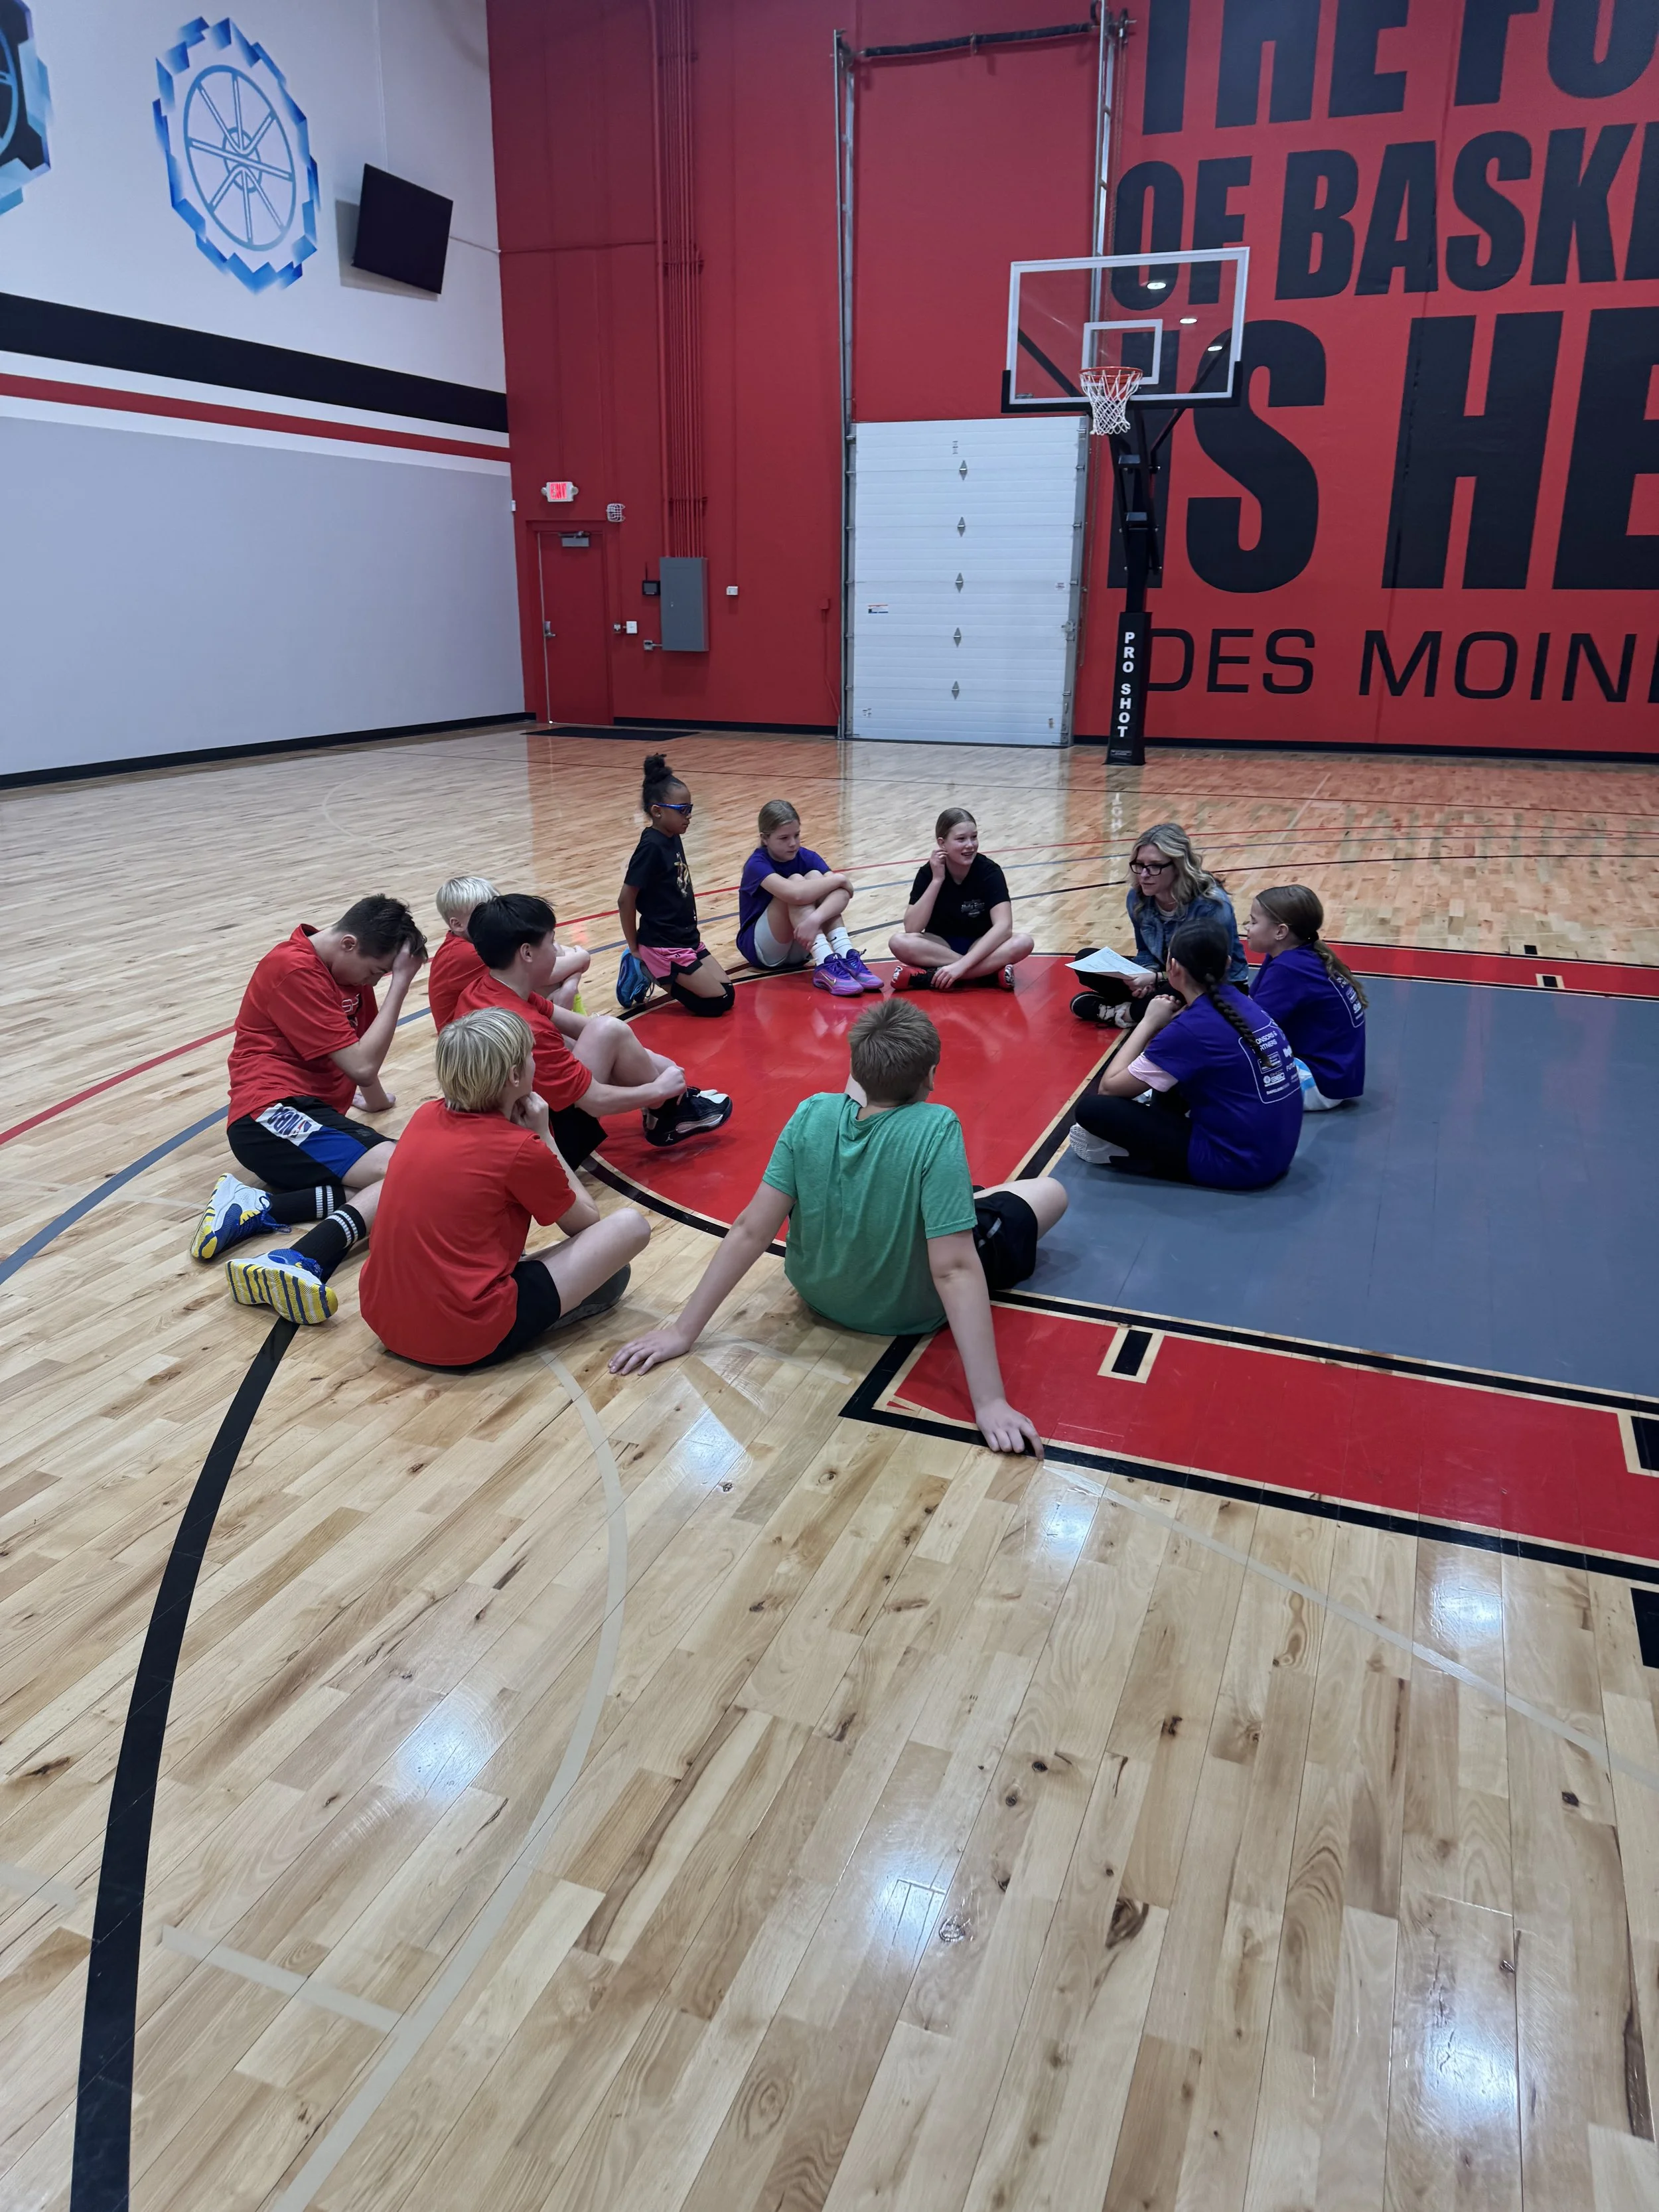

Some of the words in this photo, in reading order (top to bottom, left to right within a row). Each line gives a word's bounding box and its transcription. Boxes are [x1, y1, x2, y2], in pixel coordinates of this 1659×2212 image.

[1111, 156, 1253, 311] OF
[1107, 319, 1326, 593] IS
[1122, 632, 1135, 673] PRO
[1148, 628, 1315, 694] DES
[1358, 629, 1659, 704] MOIN
[1117, 683, 1131, 737] SHOT
